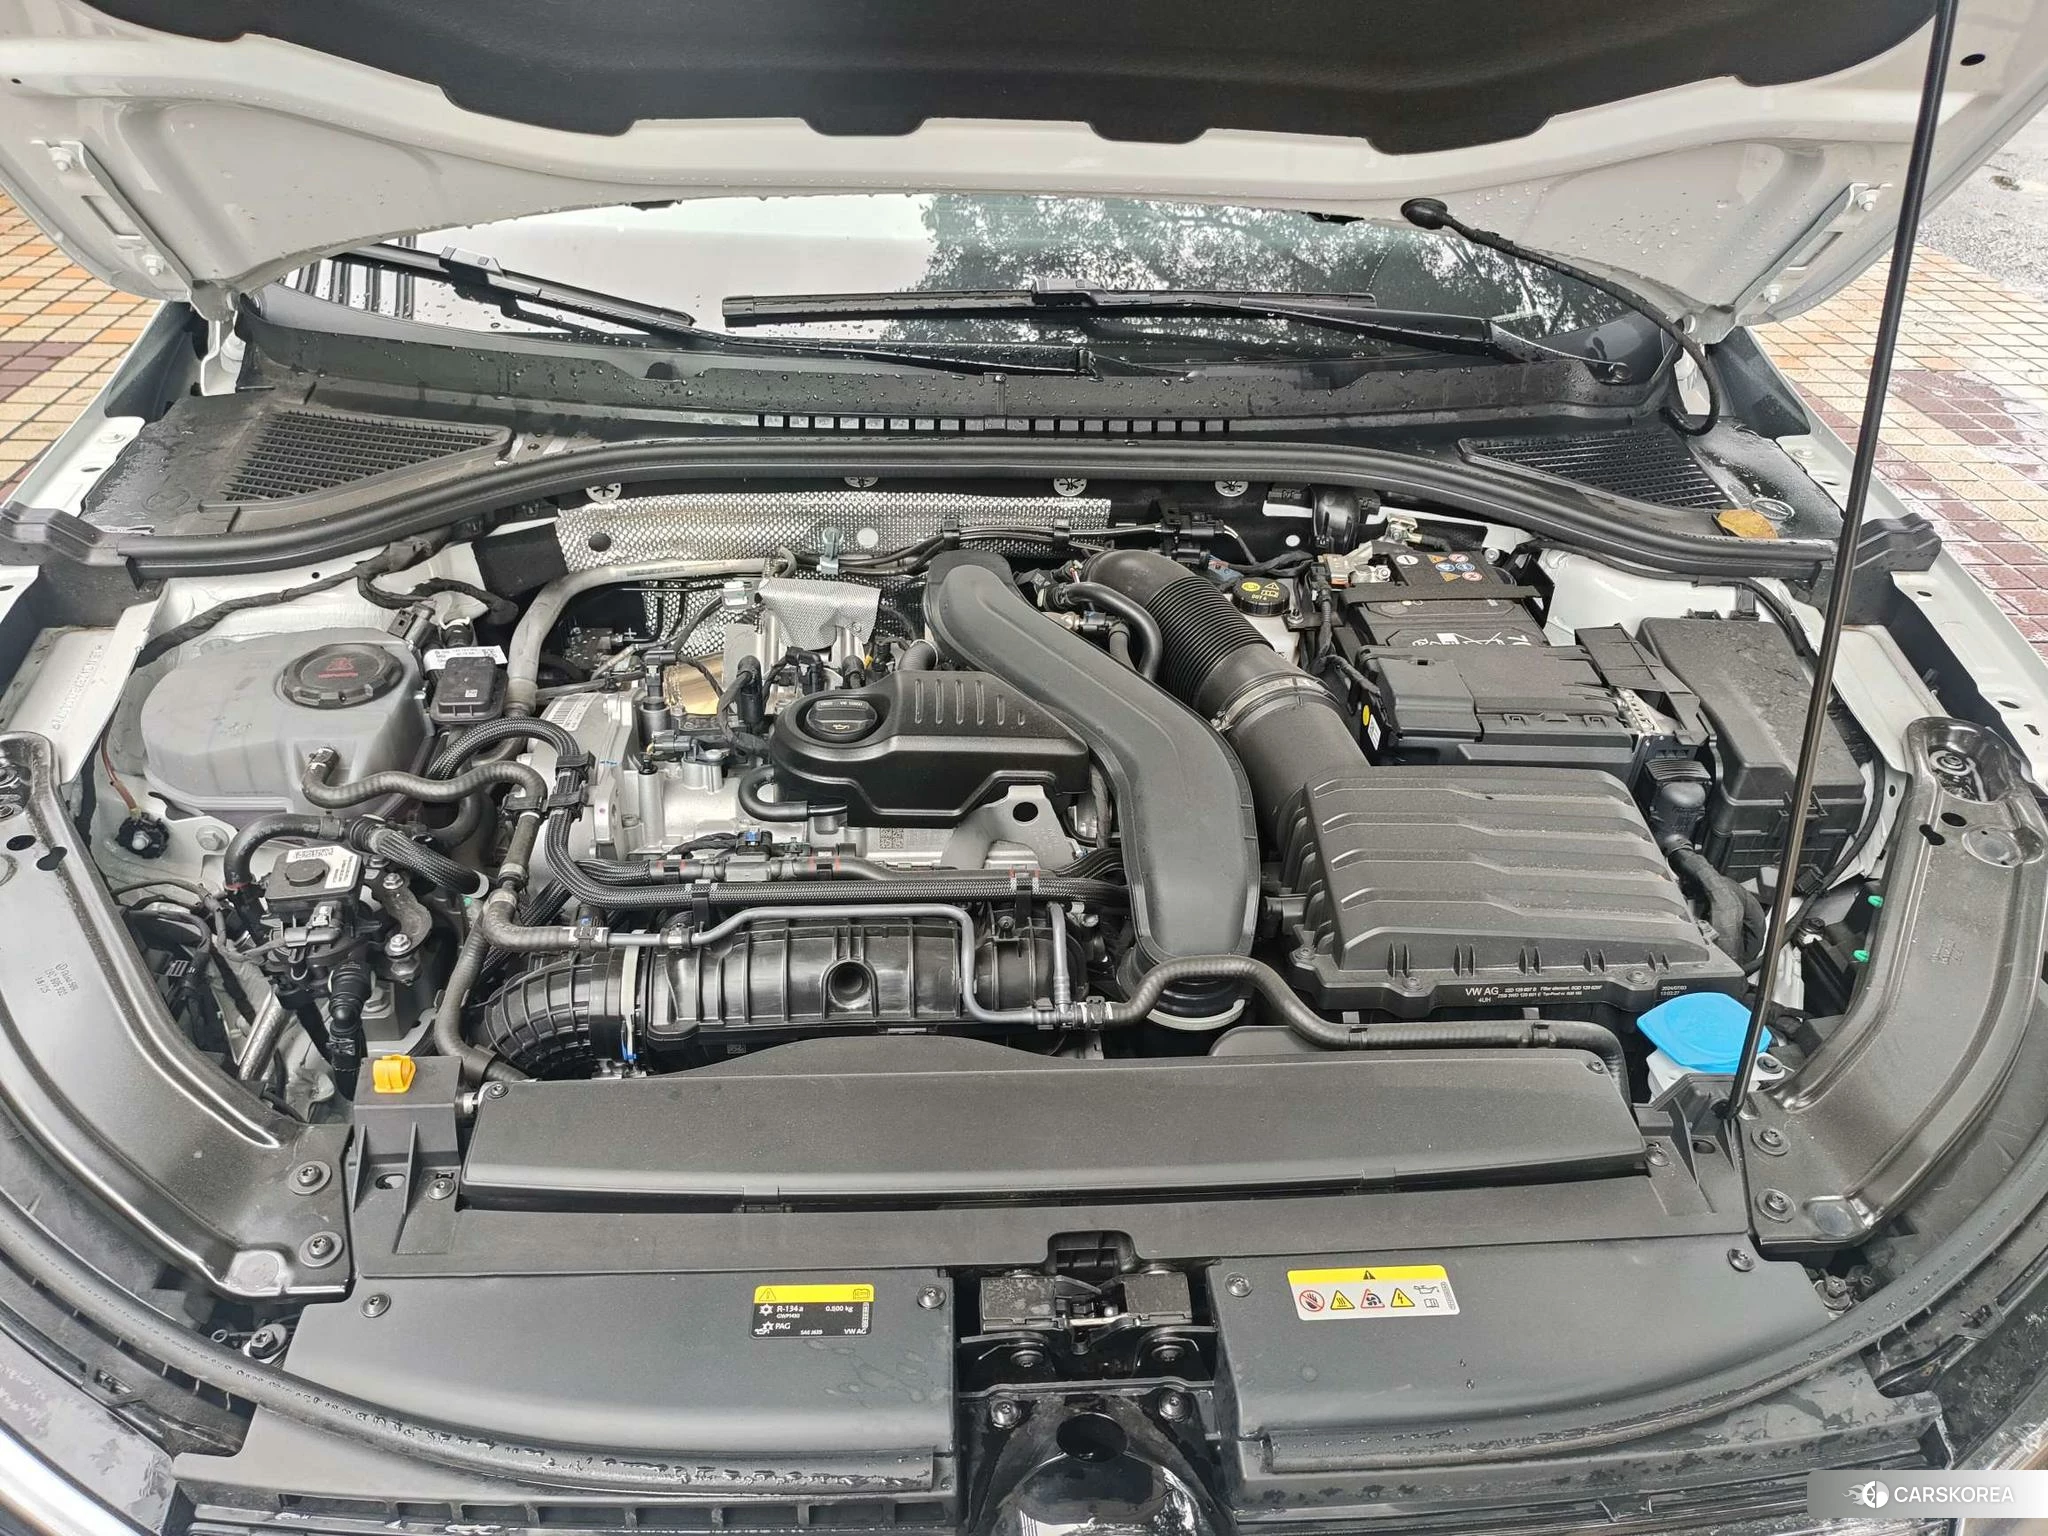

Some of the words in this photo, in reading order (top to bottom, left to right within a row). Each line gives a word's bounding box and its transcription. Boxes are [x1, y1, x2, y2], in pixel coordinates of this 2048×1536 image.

[1465, 987, 1483, 996] VW
[1483, 986, 1499, 996] AG
[844, 1305, 854, 1313] kg
[775, 1322, 791, 1330] PAG
